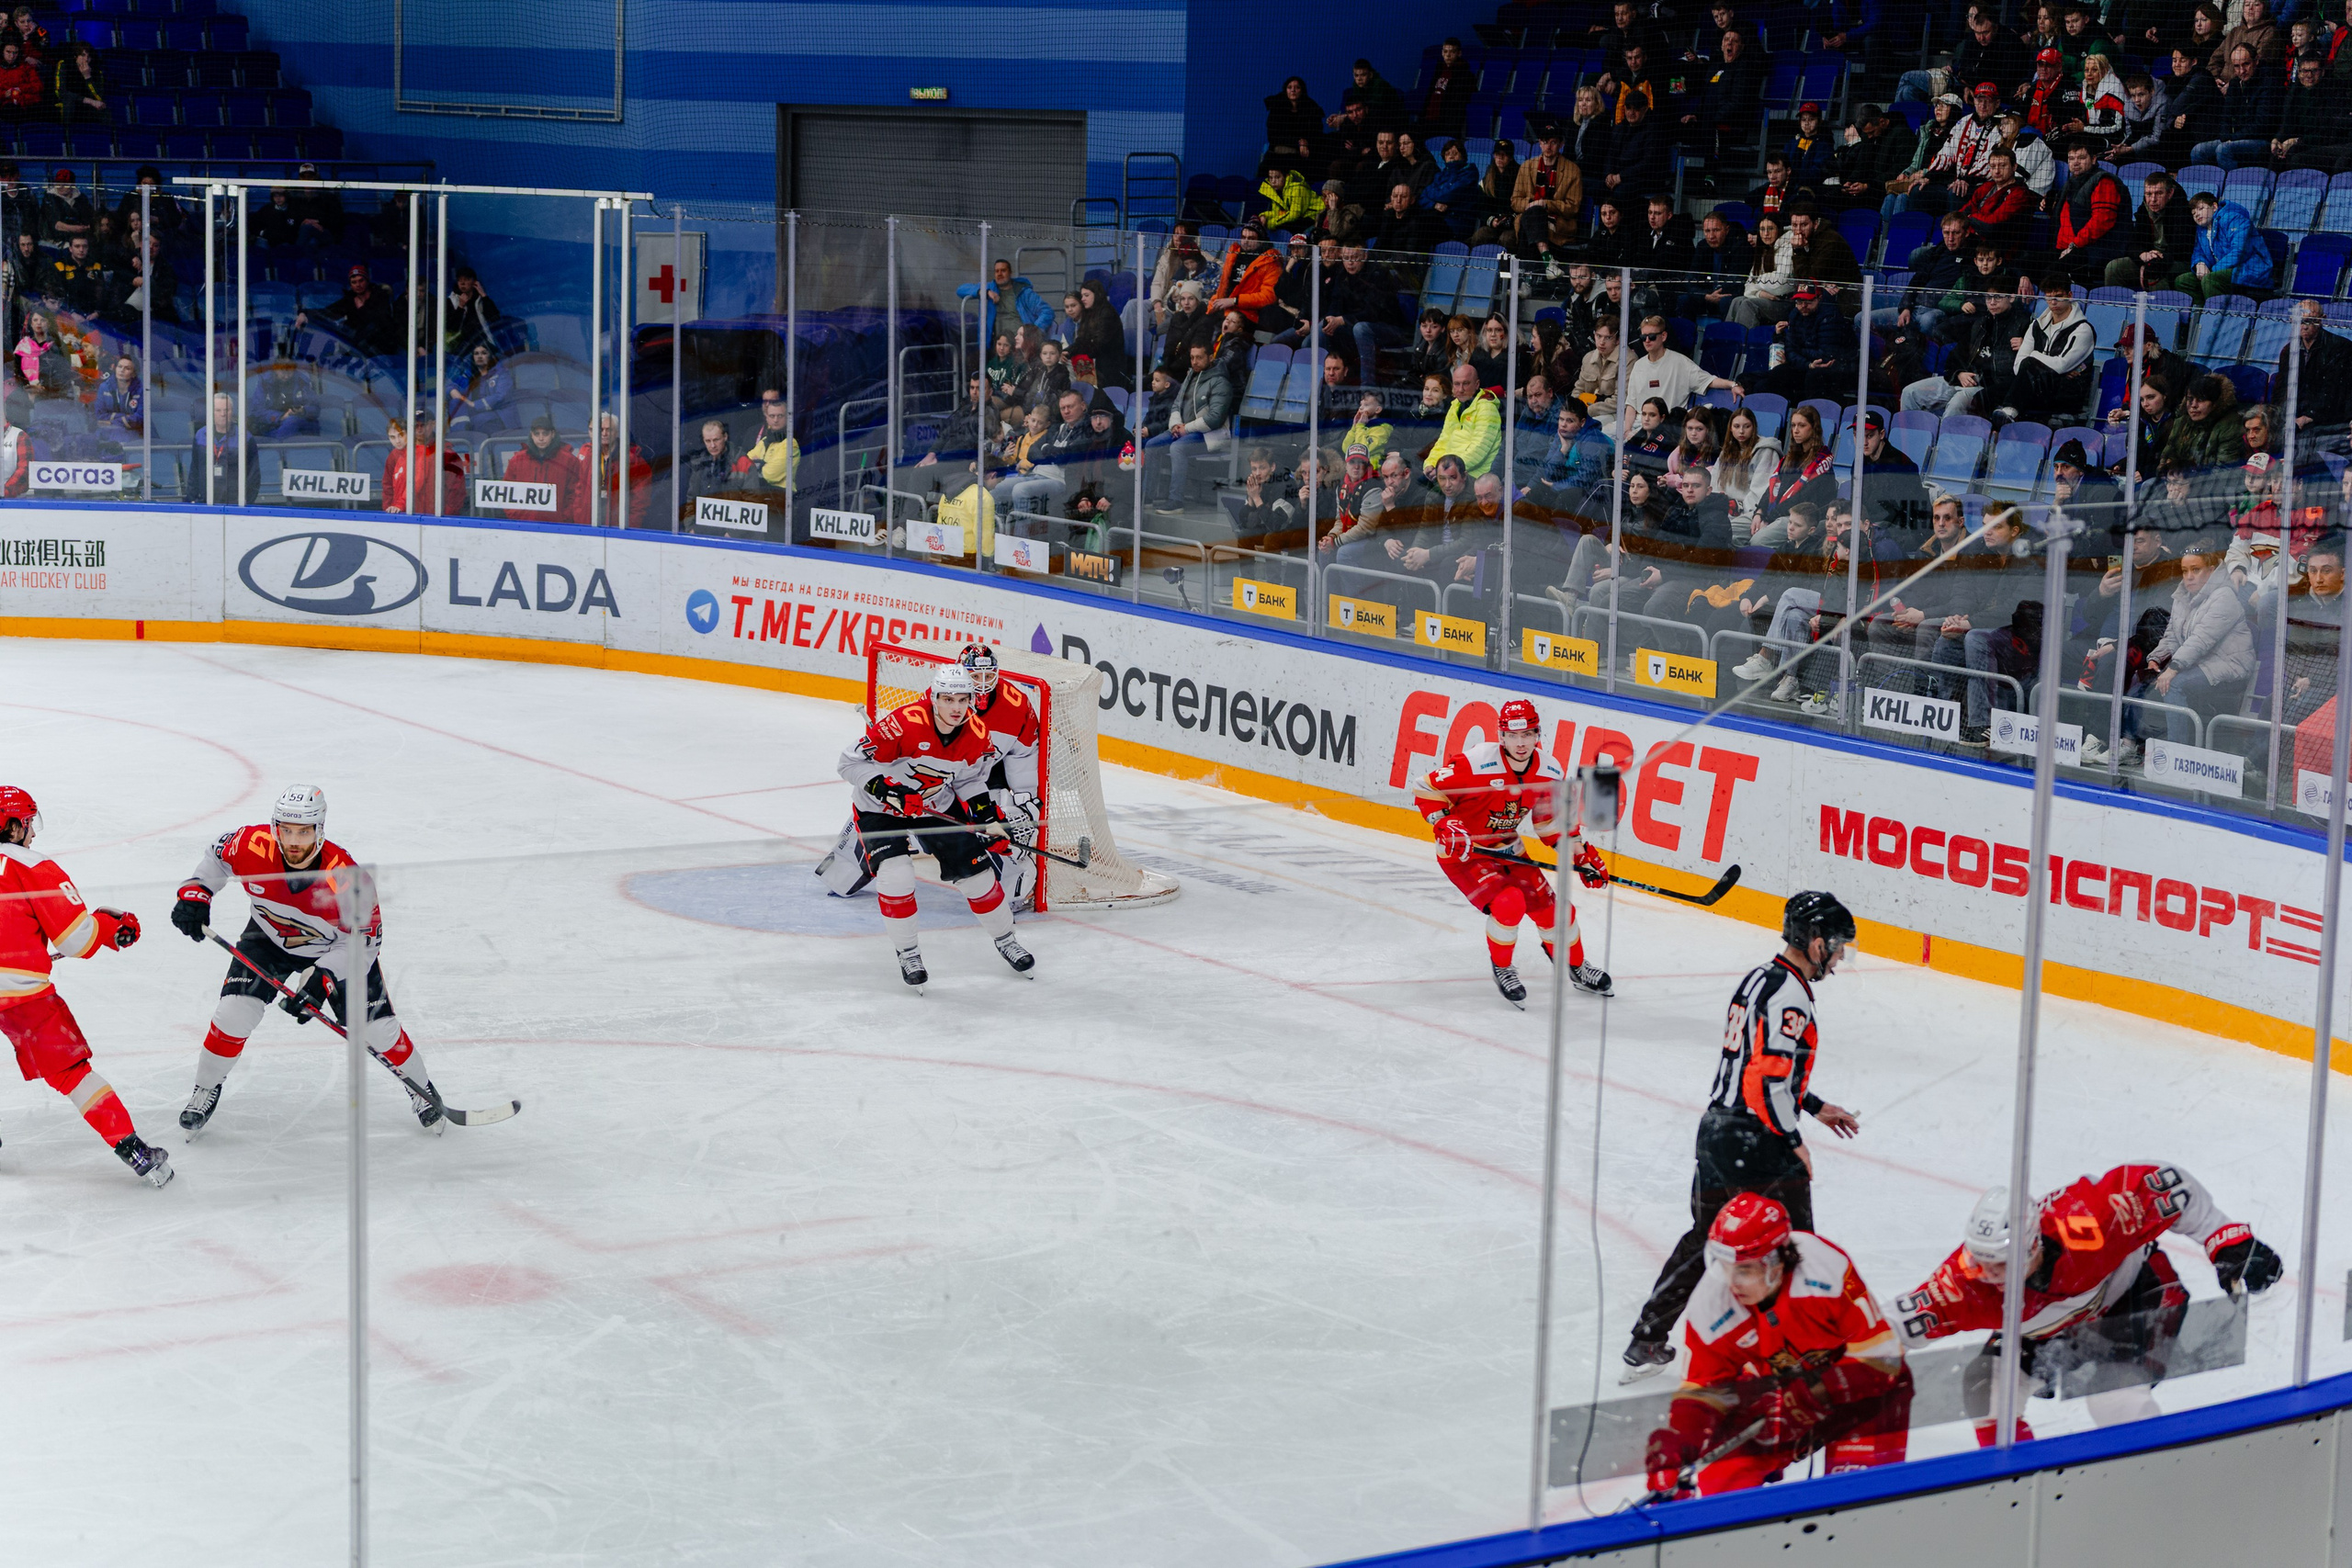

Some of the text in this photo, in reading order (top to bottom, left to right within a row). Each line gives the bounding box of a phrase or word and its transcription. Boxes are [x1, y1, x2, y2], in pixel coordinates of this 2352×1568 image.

[36, 466, 116, 486] согаз
[288, 473, 365, 495] KHL.RU
[481, 484, 552, 505] KHL.RU
[700, 502, 763, 526] KHL.RU
[814, 513, 871, 537] KHL.RU
[924, 535, 939, 543] АВТО
[928, 541, 945, 551] РАДИО
[1012, 548, 1025, 558] АВТО
[1015, 557, 1032, 568] РАДИО
[1070, 551, 1114, 582] МАТЧ!
[21, 571, 70, 589] HOCKEY
[74, 572, 107, 590] CLUB
[449, 557, 621, 618] LADA
[732, 575, 1004, 631] МЫ ВСЕГДА НА СВЯЗИ #REDSTARHOCKEY #UNITEDWEWIN
[1259, 592, 1286, 608] БАНК
[731, 594, 1001, 658] T.ME/KRS
[1356, 611, 1385, 626] БАНК
[1443, 627, 1474, 643] БАНК
[1553, 646, 1586, 663] БАНК
[949, 668, 962, 676] 74
[1668, 666, 1703, 683] БАНК
[1869, 694, 1955, 732] KHL.RU
[2019, 727, 2076, 753] ГАЗБАНК
[2174, 757, 2238, 784] ГАЗПРОМБАНК
[288, 793, 304, 802] 59
[184, 890, 211, 903] CC
[1976, 1219, 1995, 1236] 56
[2206, 1224, 2250, 1256] AUER
[1896, 1289, 1939, 1338] 56
